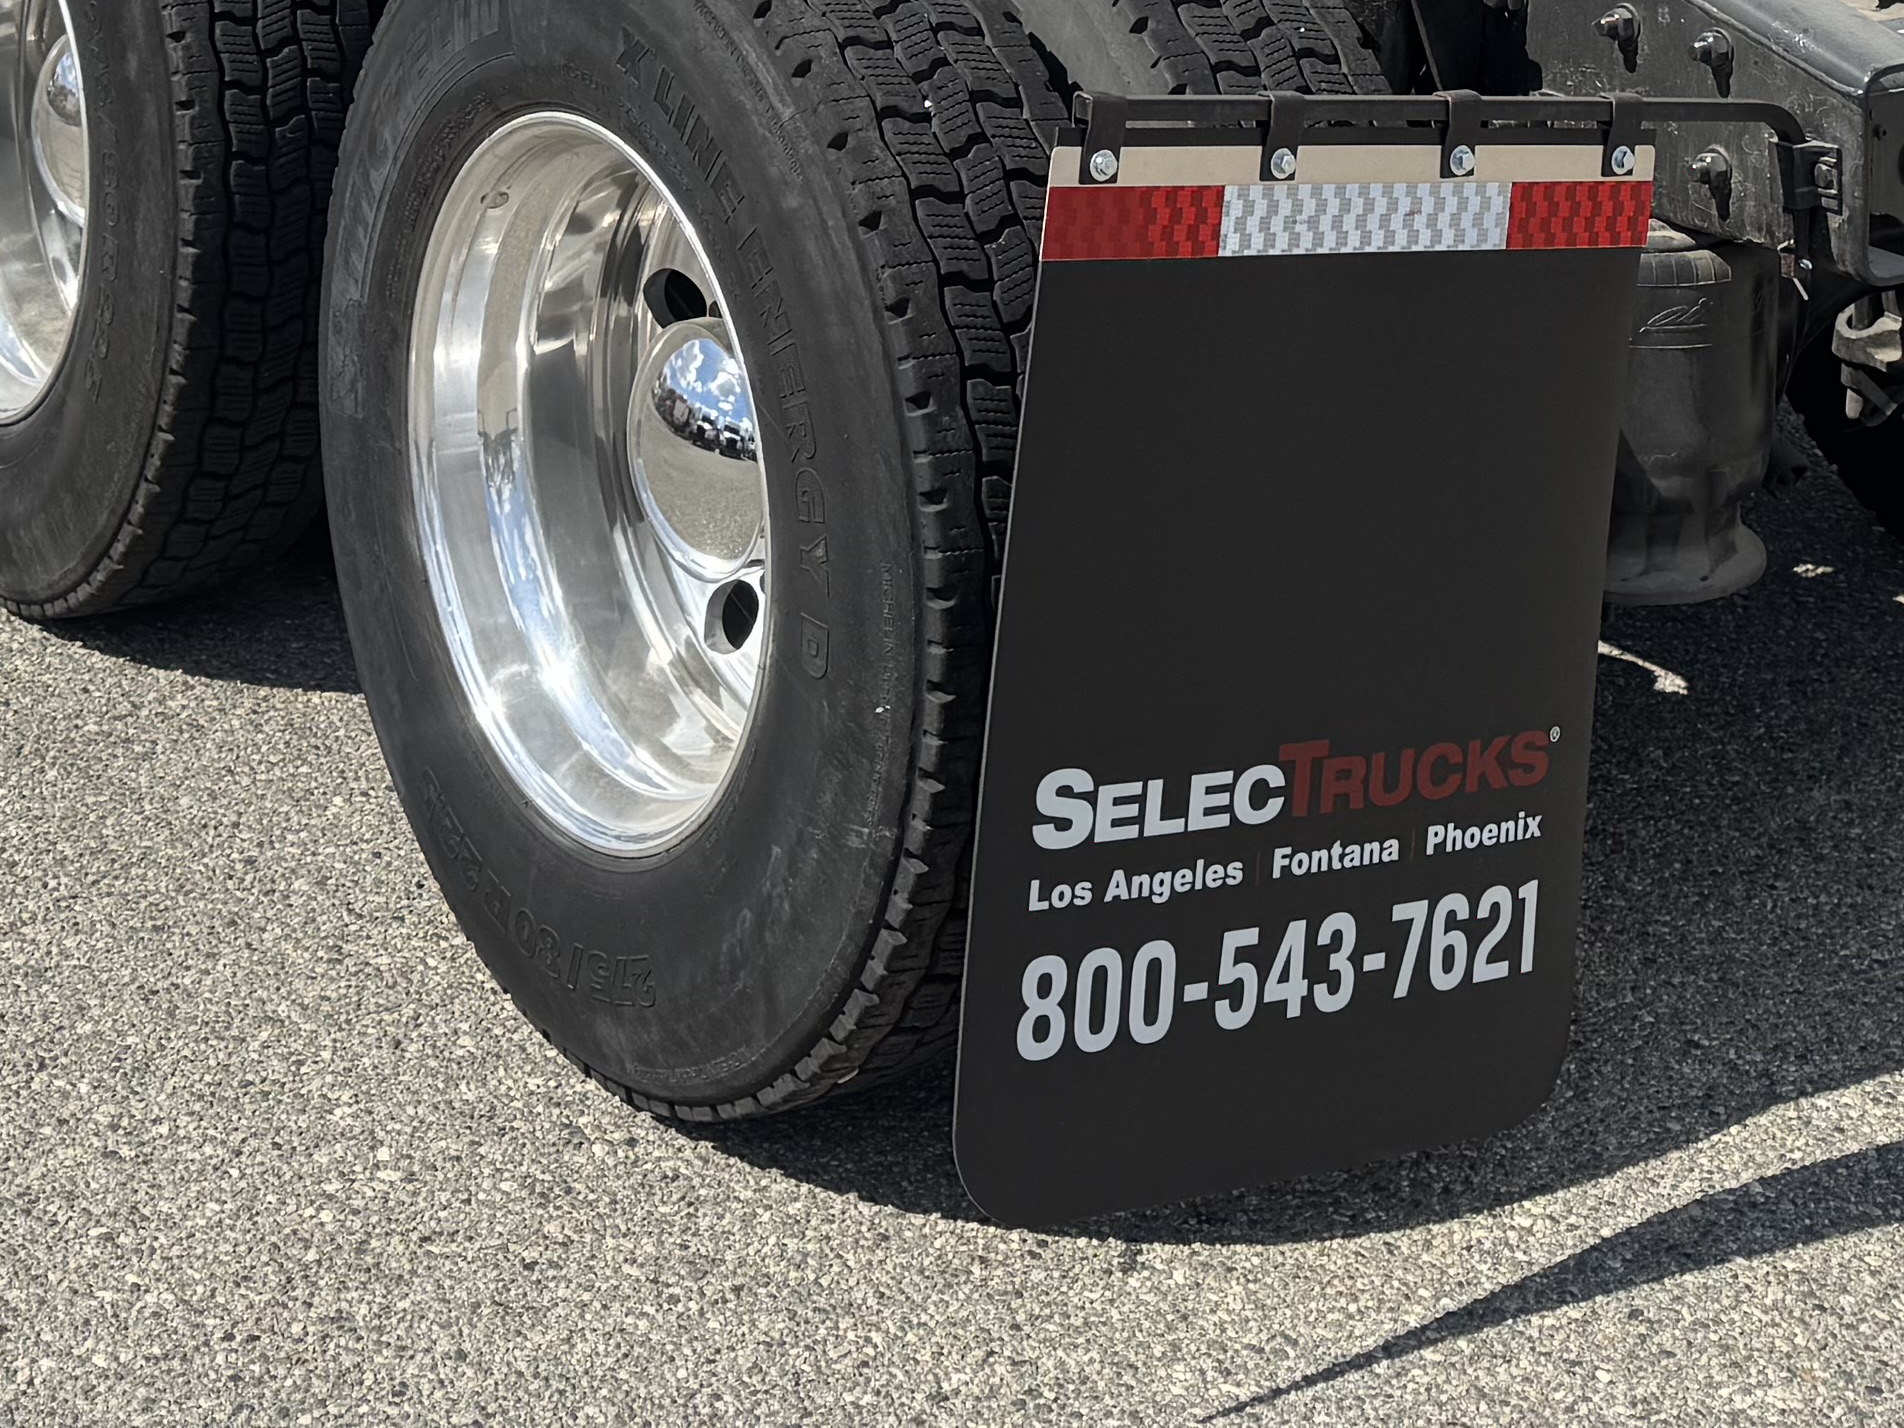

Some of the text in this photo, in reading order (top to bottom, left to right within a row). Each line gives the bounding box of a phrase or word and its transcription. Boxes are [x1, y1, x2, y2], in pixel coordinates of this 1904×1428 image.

[1028, 811, 1543, 912] Los Angeles Fontana Phoenix
[1016, 879, 1540, 1062] 800-543-7621
